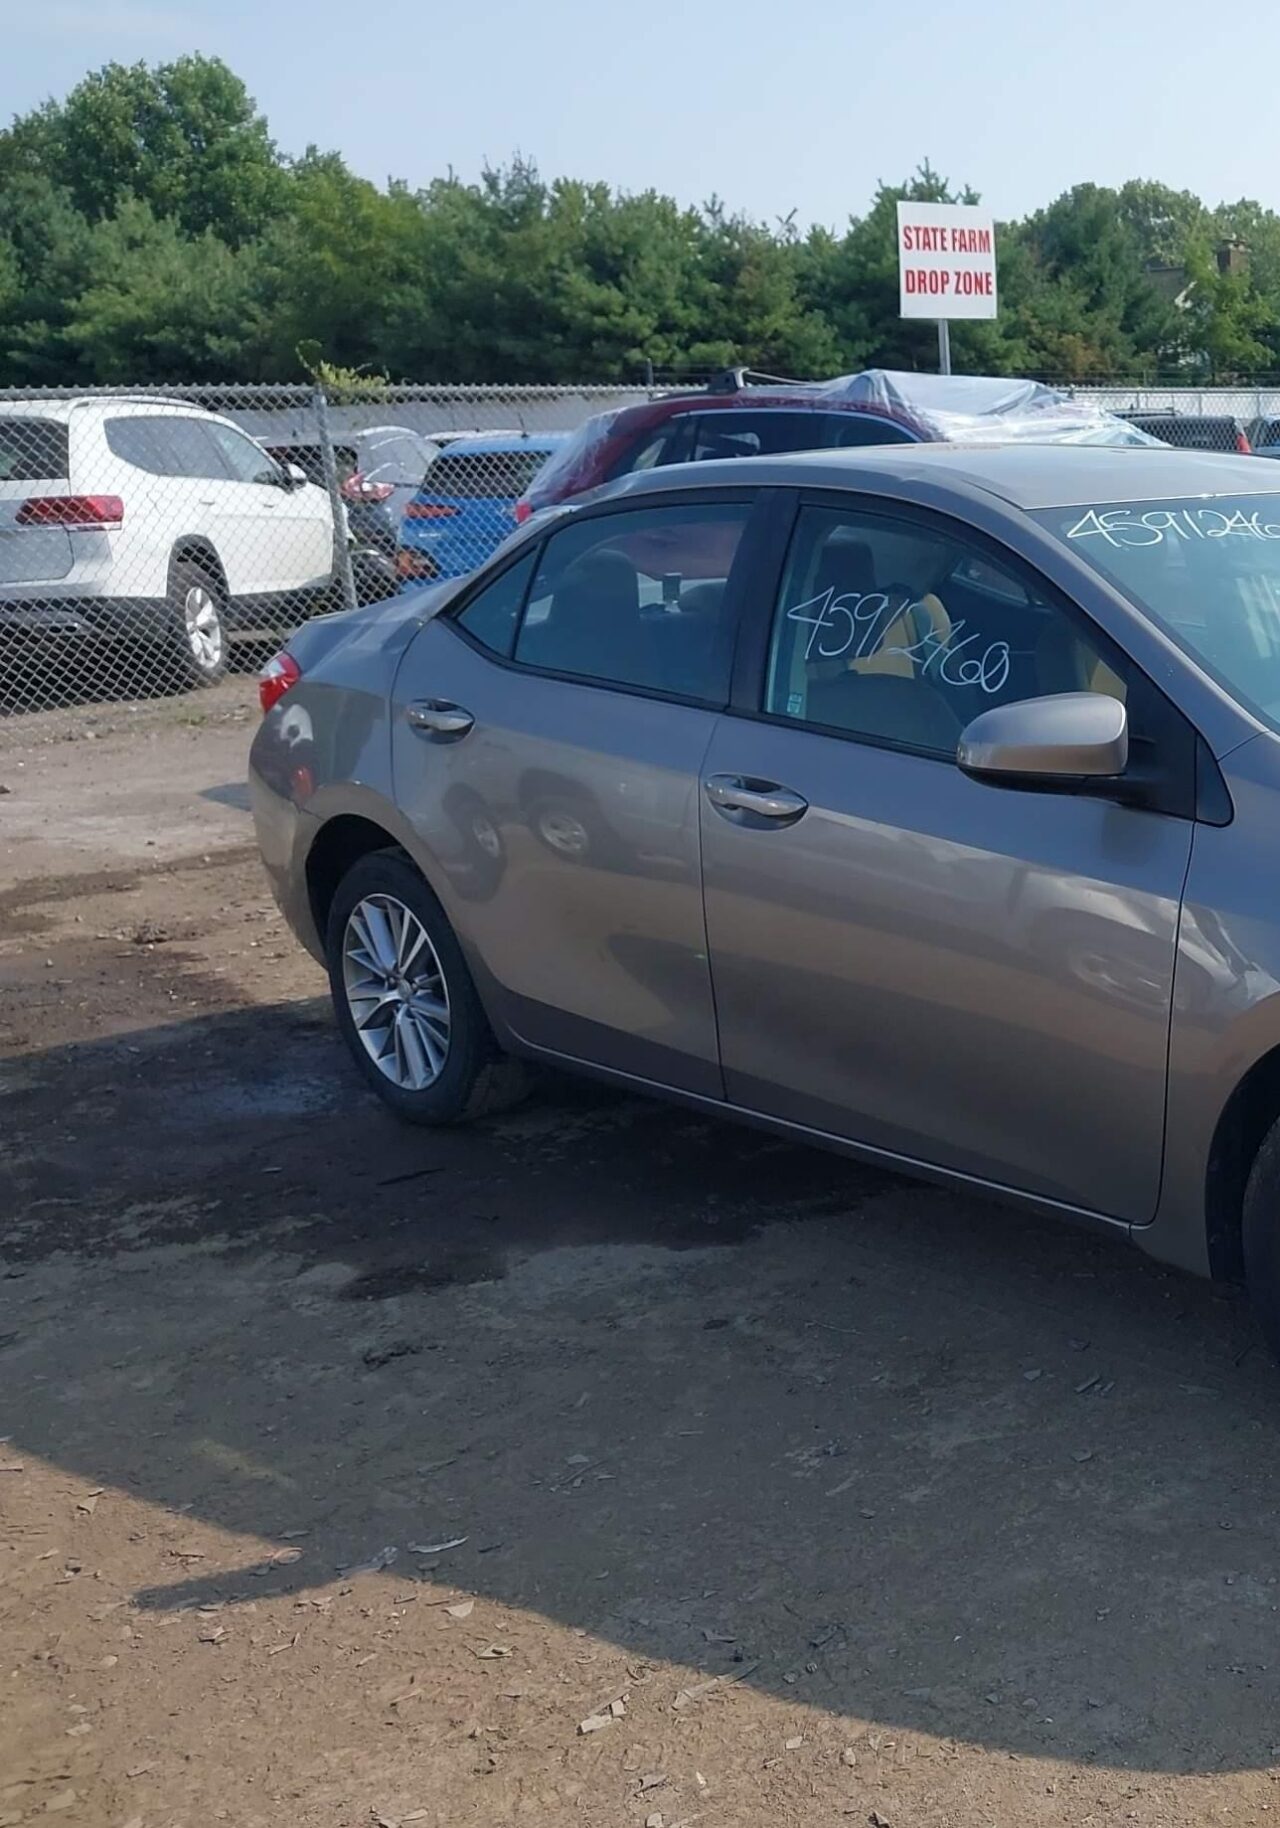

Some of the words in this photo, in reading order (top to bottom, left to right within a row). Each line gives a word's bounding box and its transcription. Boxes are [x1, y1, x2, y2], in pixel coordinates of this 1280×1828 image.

[903, 225, 947, 252] STATE
[952, 228, 991, 253] FARM
[905, 269, 950, 295] DROP
[954, 271, 993, 295] ZONE
[786, 585, 1010, 693] 45912460
